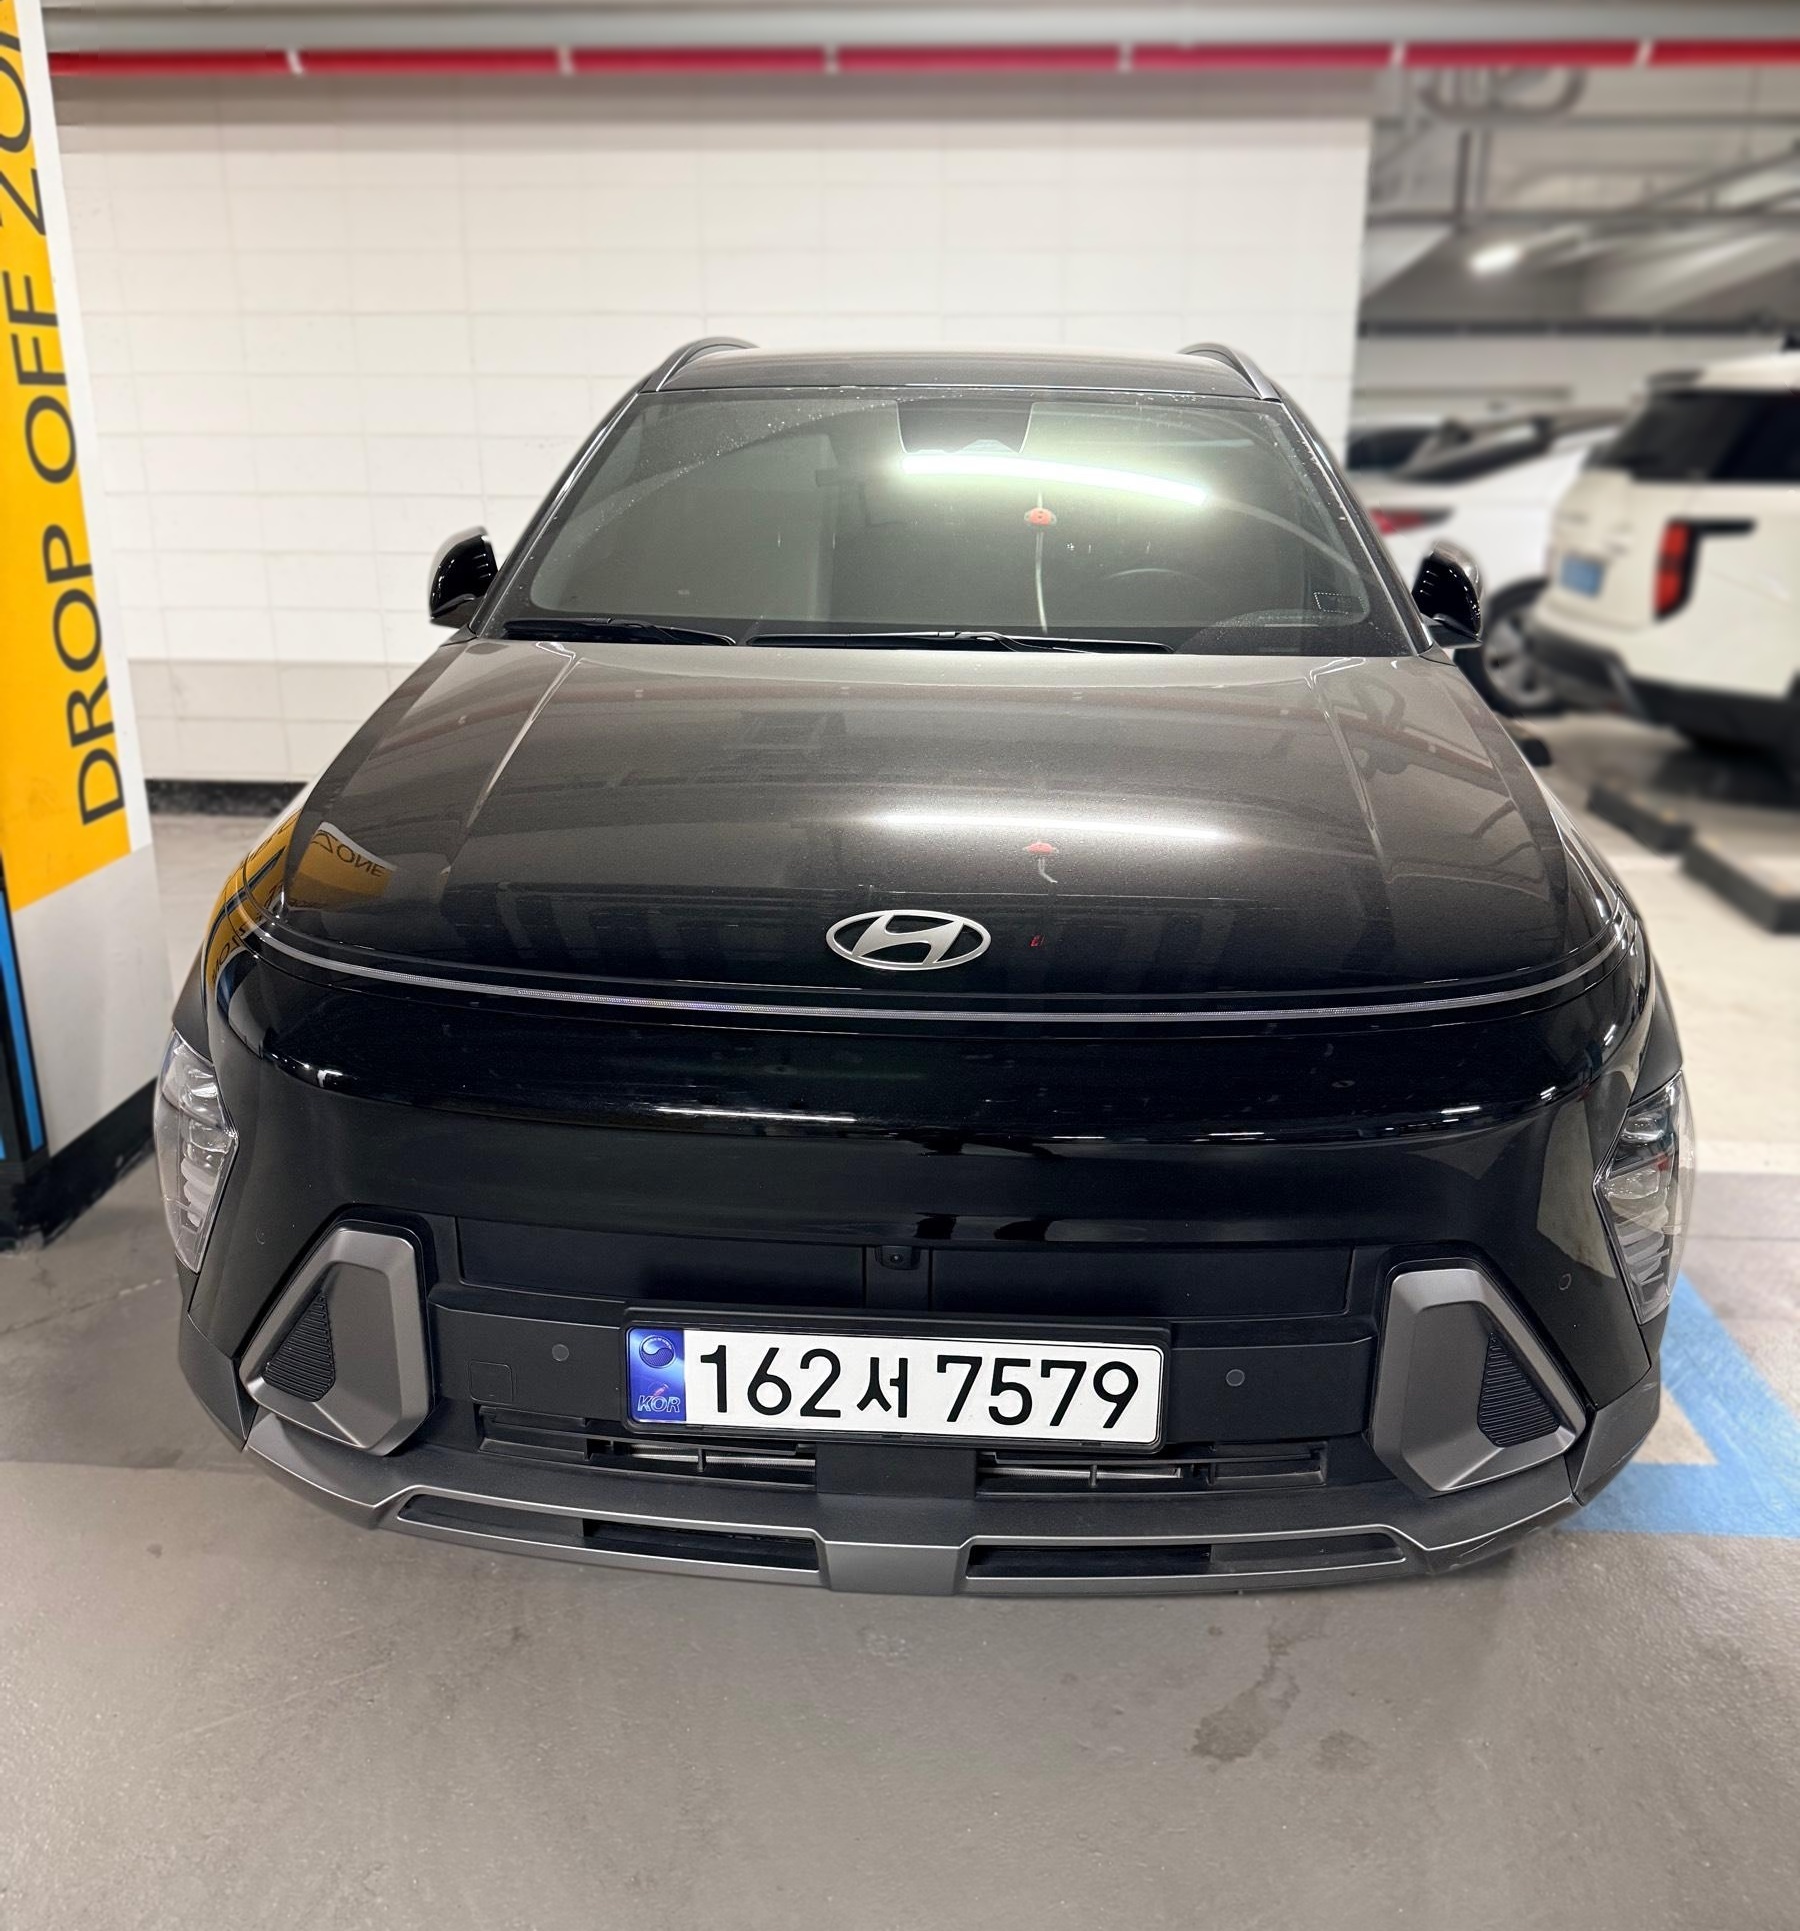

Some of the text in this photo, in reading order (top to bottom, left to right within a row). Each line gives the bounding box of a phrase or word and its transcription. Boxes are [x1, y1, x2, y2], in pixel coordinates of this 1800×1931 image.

[0, 31, 125, 826] DROP OFF ZO
[637, 1394, 681, 1413] KOR
[700, 1344, 1139, 1429] 162서 7579
